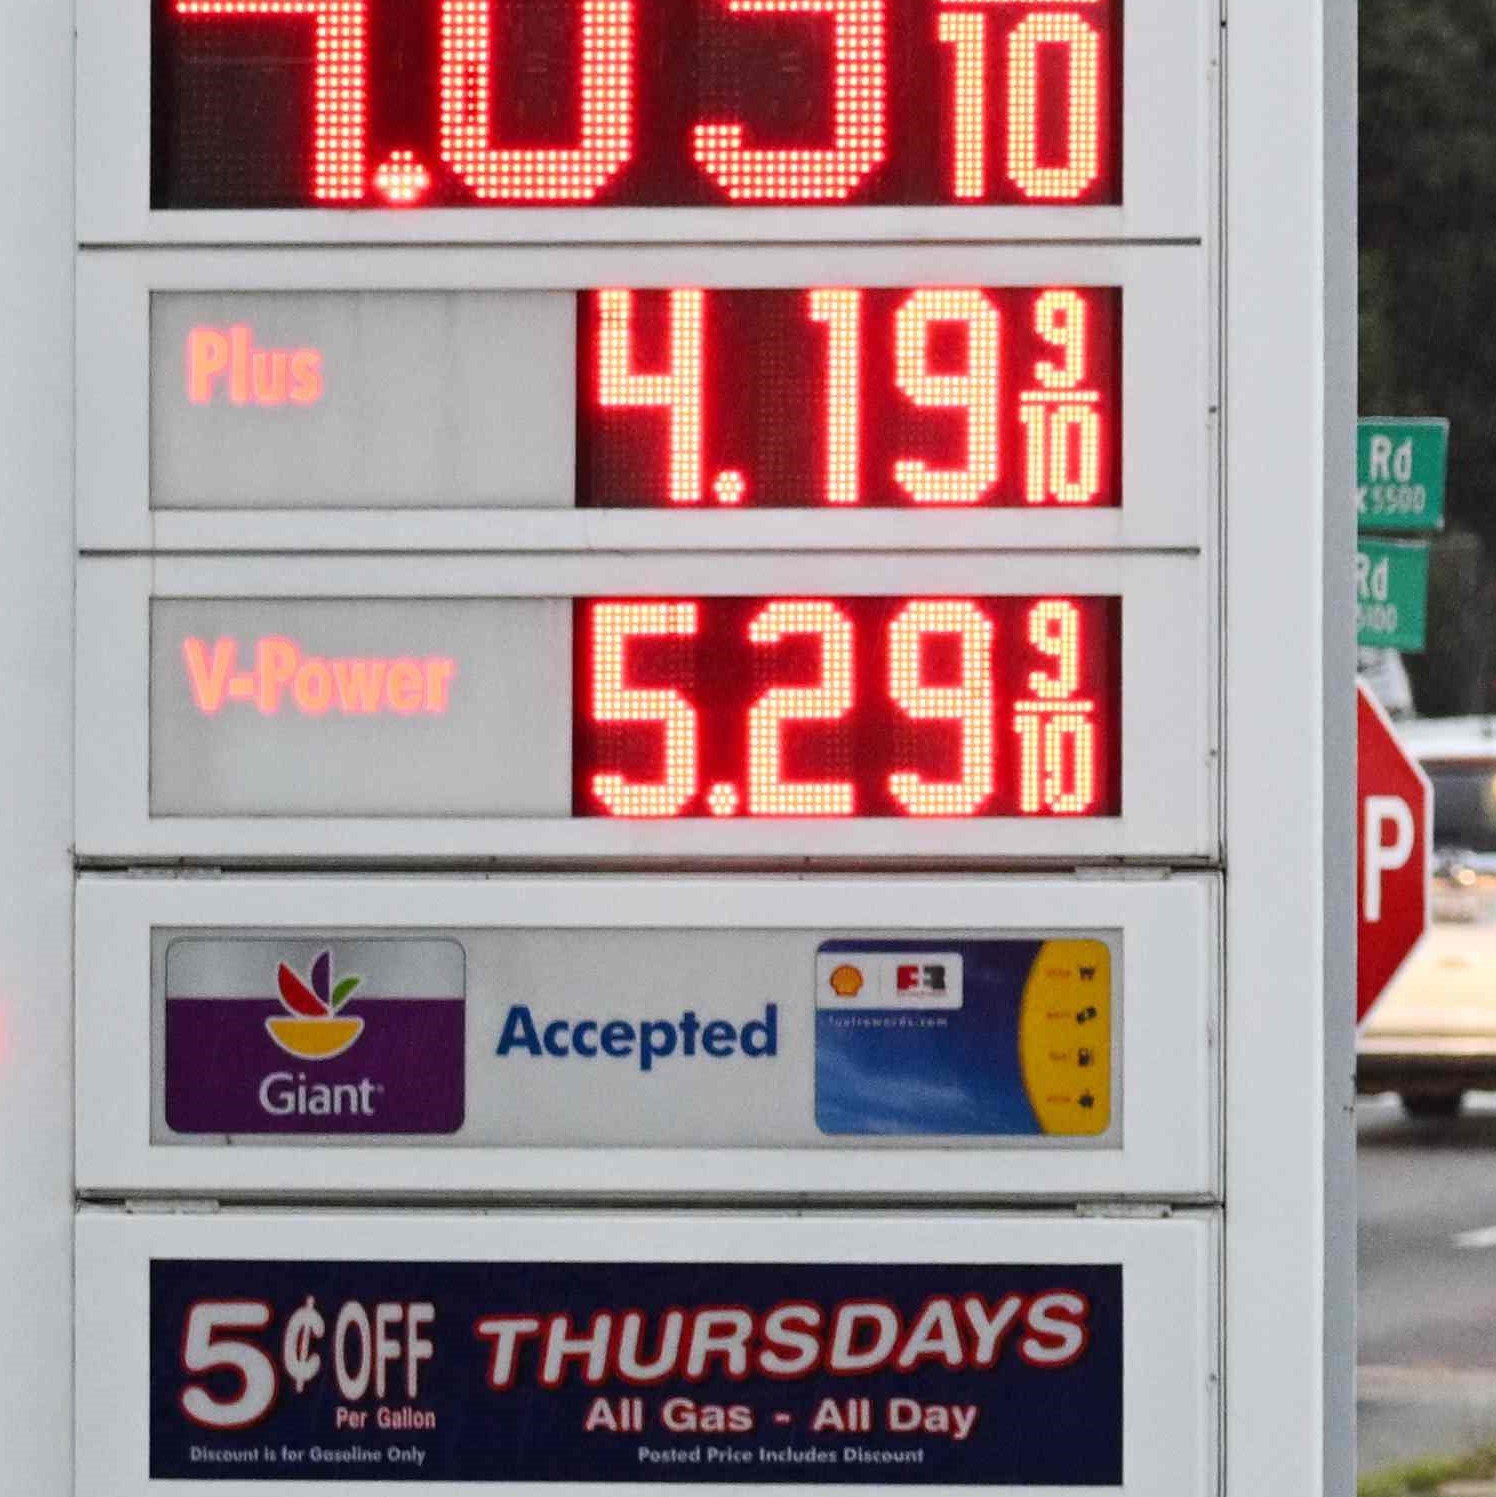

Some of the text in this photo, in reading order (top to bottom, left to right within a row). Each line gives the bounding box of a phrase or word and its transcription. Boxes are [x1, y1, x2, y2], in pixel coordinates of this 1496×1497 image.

[186, 328, 324, 406] Plus
[594, 287, 1003, 504] 4.19
[1370, 435, 1412, 482] Rd
[186, 636, 454, 715] V-Power
[591, 601, 995, 818] 5.29
[495, 1003, 779, 1071] Accepted
[259, 1072, 376, 1116] Giant
[334, 1301, 435, 1401] OFF
[474, 1289, 1090, 1387] THURSDAYS
[336, 1407, 436, 1428] Per Gallon
[585, 1399, 642, 1432] All
[662, 1398, 753, 1432] Gas
[813, 1398, 870, 1432] All
[888, 1398, 977, 1440] Day
[190, 1445, 426, 1466] Discount is for Gasoline Only
[638, 1447, 924, 1463] Posted Price Includes Discount
